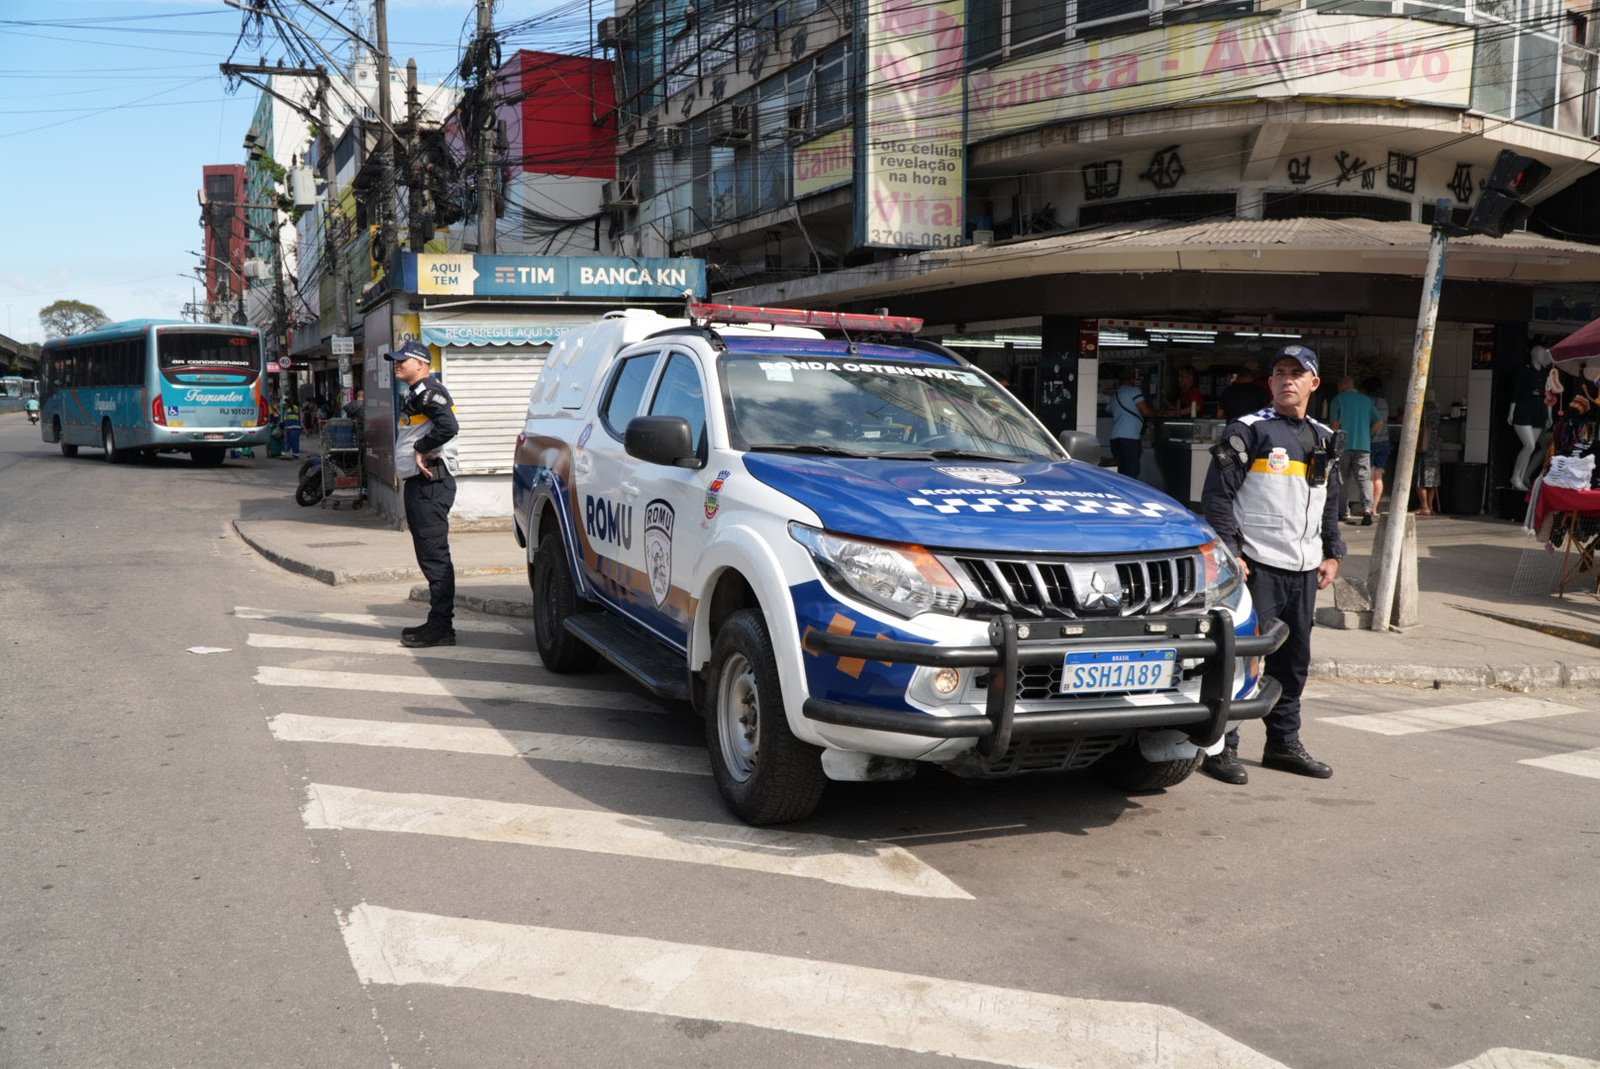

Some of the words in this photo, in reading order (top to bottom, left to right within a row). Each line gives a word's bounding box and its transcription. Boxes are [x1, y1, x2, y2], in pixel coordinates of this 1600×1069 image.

[974, 54, 1138, 116] Caneca
[1200, 26, 1451, 84] Adesivo
[871, 138, 906, 153] Foto
[911, 143, 963, 158] celular
[880, 156, 956, 173] revelação
[889, 172, 907, 182] na
[912, 171, 947, 186] hora
[873, 190, 963, 227] Vital
[871, 229, 962, 248] 3706-0618
[430, 263, 461, 274] AQUI
[518, 266, 554, 284] TIM
[580, 267, 653, 285] BANCA
[657, 268, 686, 286] KN
[434, 275, 458, 285] TEM
[446, 328, 513, 338] RECARREGUE
[517, 328, 542, 338] AQUI
[544, 328, 553, 337] O
[759, 361, 841, 372] RONDA
[843, 363, 960, 382] OSTENSIVA
[184, 388, 243, 405] Fagundes
[918, 488, 1000, 496] RONDA
[1002, 489, 1123, 500] OSTENSIVA
[586, 494, 633, 551] ROMU
[648, 507, 672, 530] ROMU
[1073, 663, 1162, 689] SSH1A89
